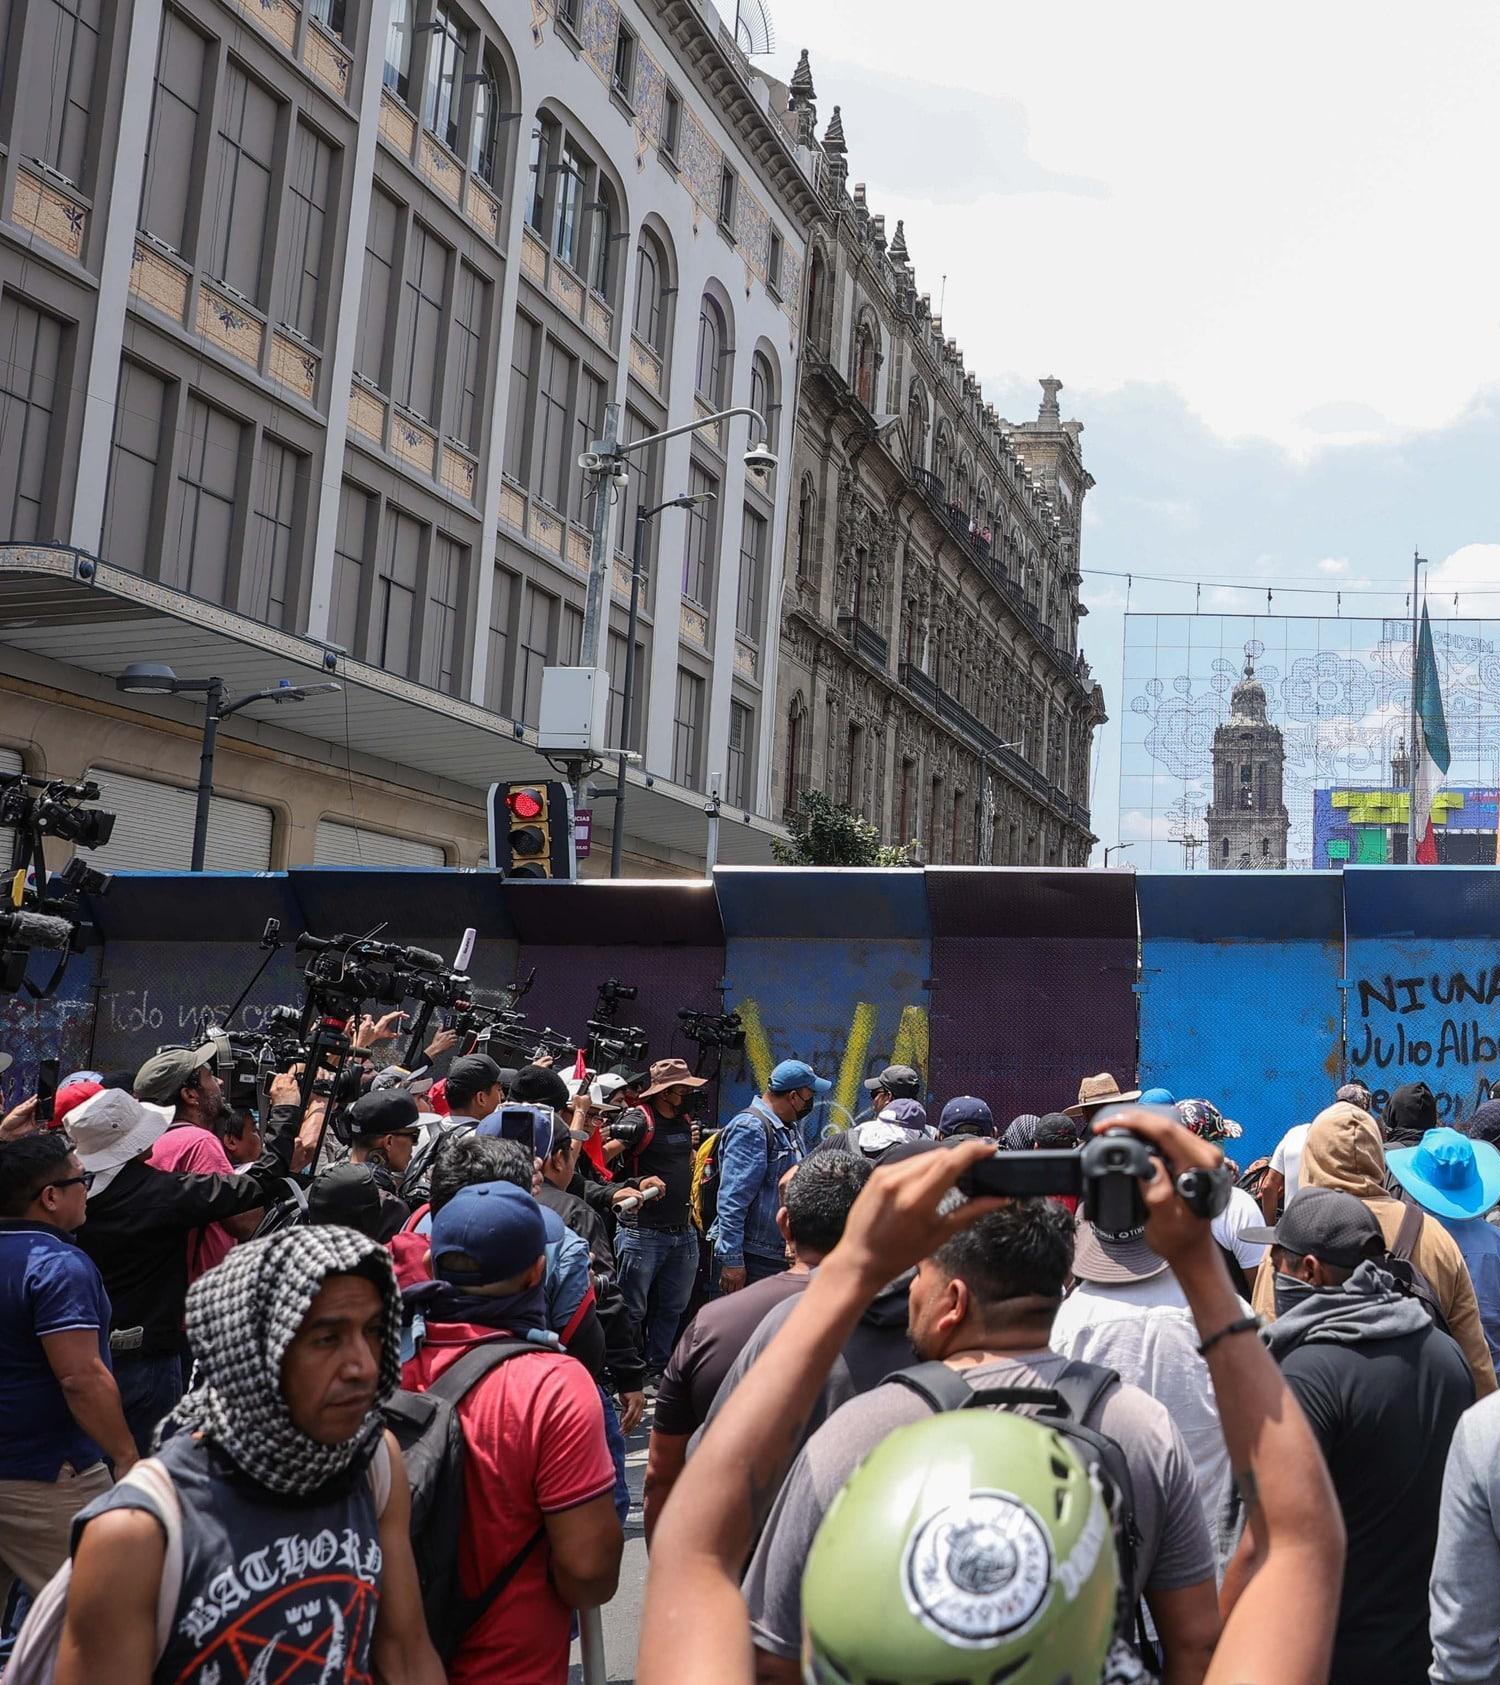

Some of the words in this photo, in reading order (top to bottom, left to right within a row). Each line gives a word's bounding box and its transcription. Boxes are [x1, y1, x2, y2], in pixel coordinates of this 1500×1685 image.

[1357, 976, 1426, 1018] NI
[1351, 1022, 1433, 1068] Julio
[178, 1528, 383, 1648] BATHORY
